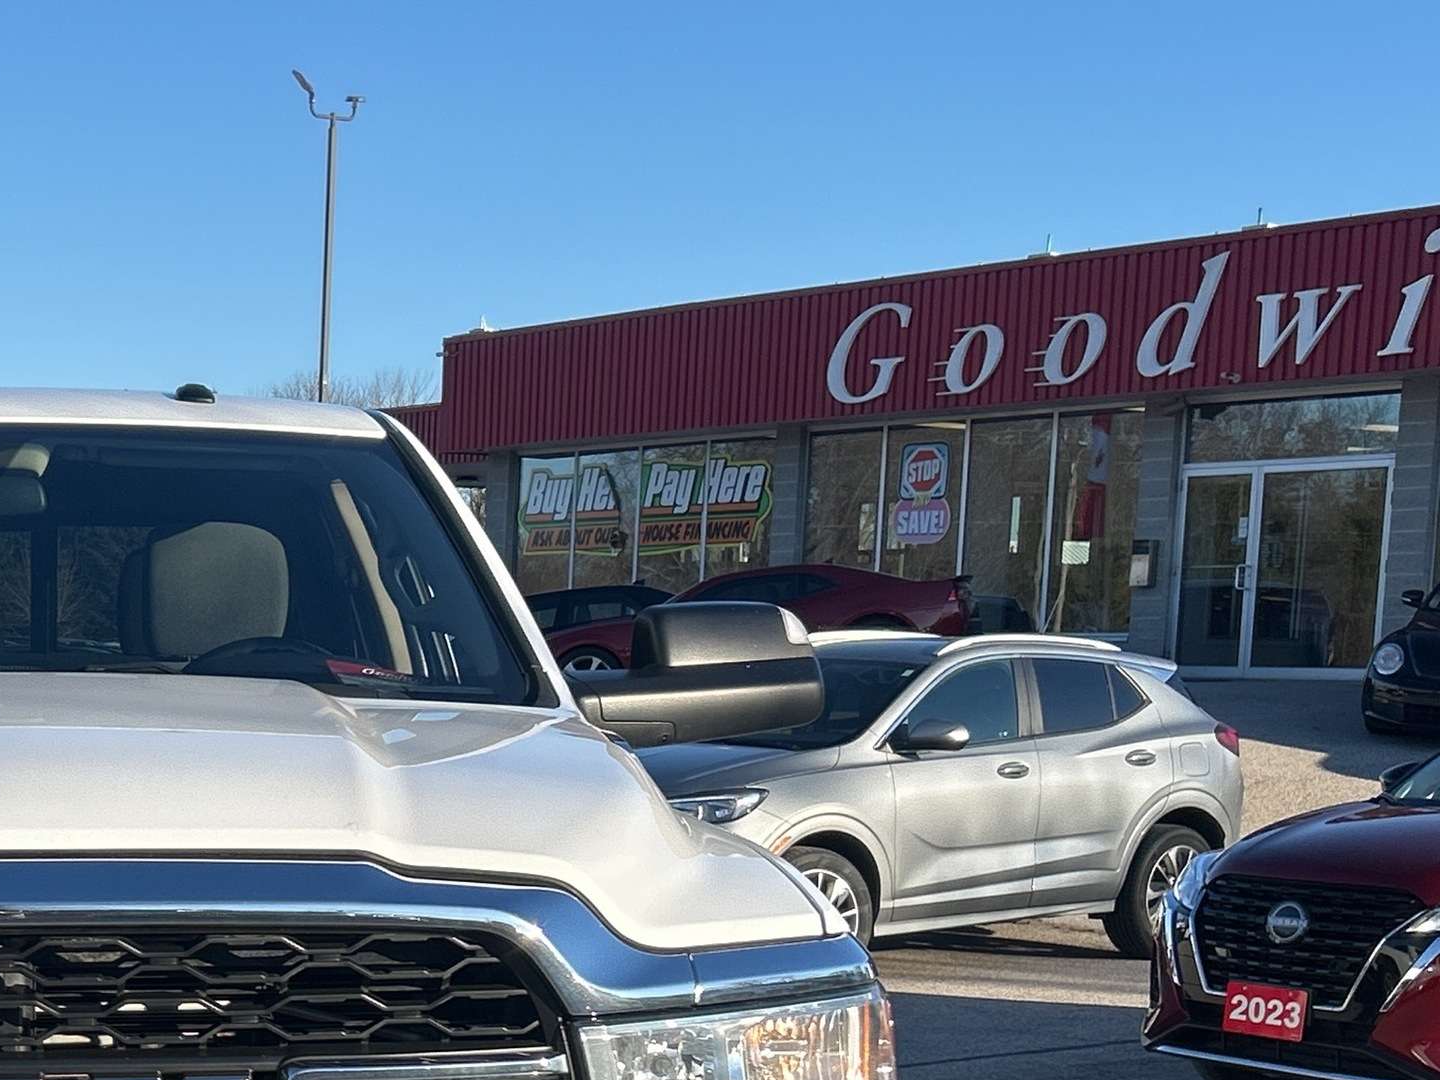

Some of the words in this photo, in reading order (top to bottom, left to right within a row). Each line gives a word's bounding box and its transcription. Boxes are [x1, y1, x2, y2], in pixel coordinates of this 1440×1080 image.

[826, 227, 1440, 405] Goodwi
[908, 459, 940, 482] STOP
[526, 472, 574, 521] Buy
[643, 463, 697, 514] Pay
[697, 459, 767, 505] Here
[896, 510, 945, 535] SAVE!
[531, 529, 554, 547] ASK
[1229, 994, 1301, 1029] 2023
